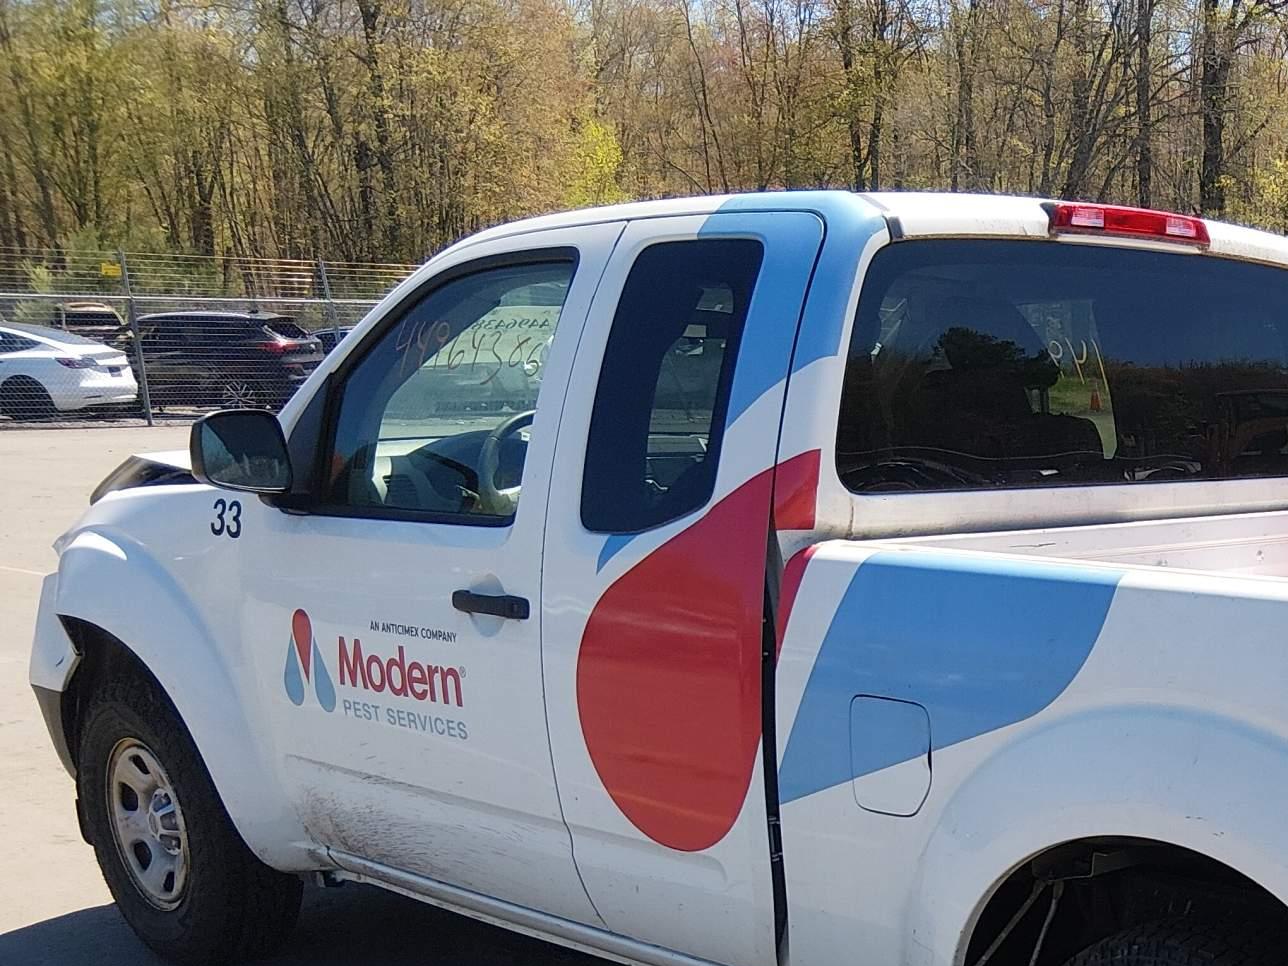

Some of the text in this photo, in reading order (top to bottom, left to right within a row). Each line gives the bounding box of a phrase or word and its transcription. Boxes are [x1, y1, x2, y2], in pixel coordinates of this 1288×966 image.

[210, 498, 242, 539] 33
[370, 620, 457, 643] AN ANTICIMEX COMPANY
[343, 699, 468, 740] PEST SERVICES
